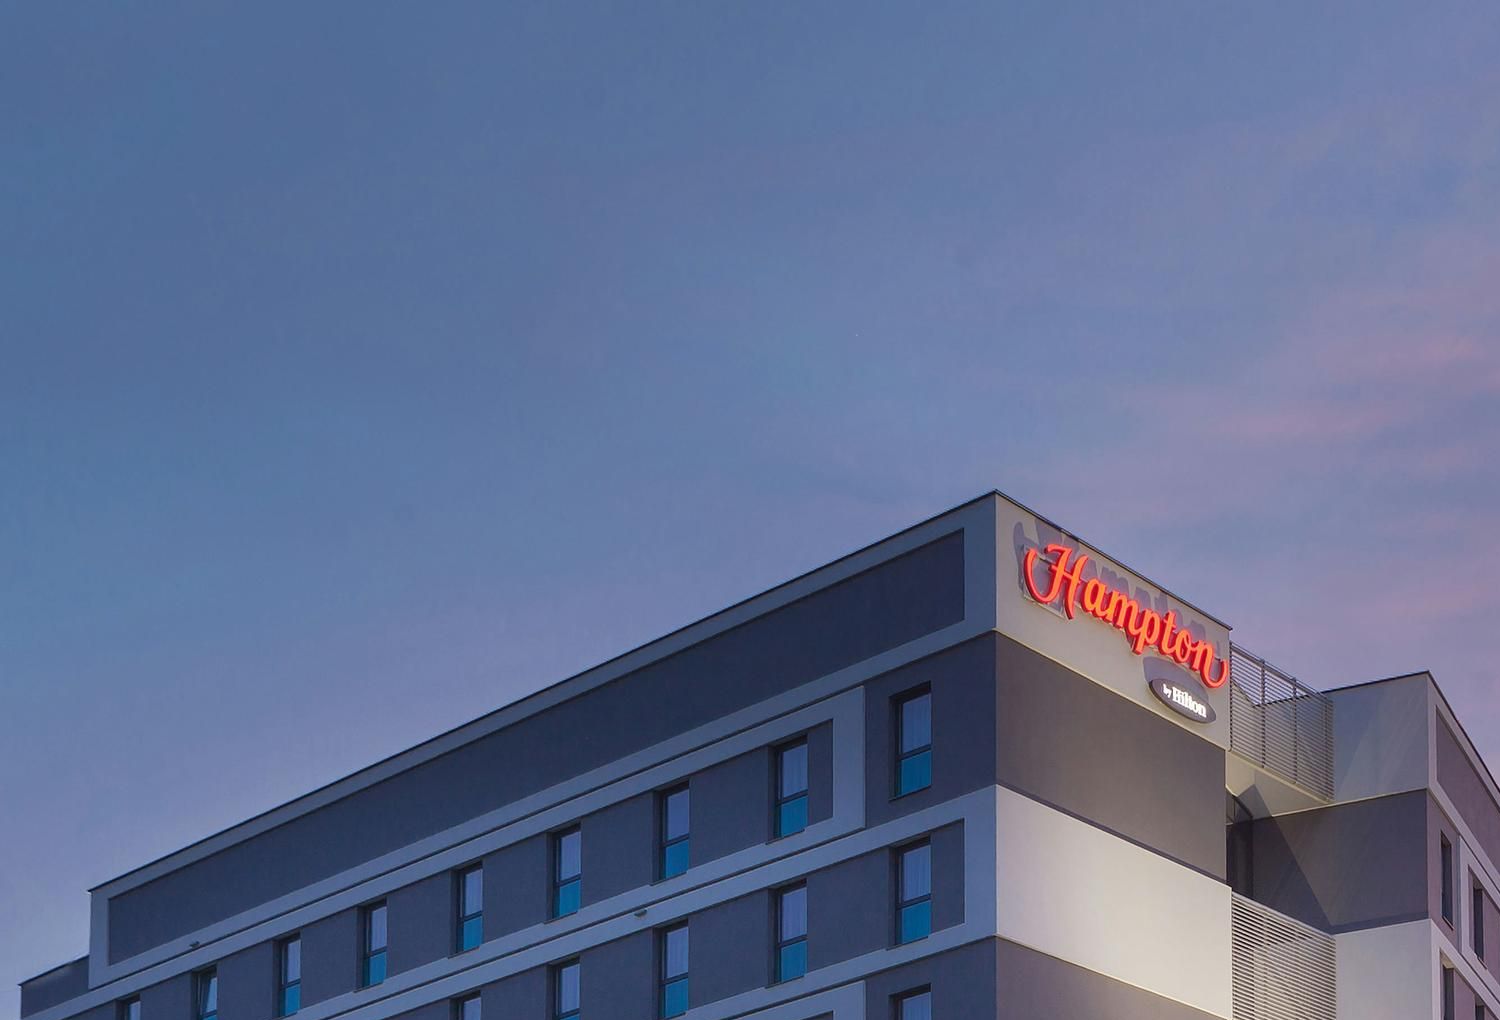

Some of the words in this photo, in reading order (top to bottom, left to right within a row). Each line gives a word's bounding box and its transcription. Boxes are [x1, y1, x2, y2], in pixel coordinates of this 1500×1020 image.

[1024, 543, 1229, 688] Hampton
[1162, 683, 1172, 699] by
[1172, 686, 1207, 718] Hilton
